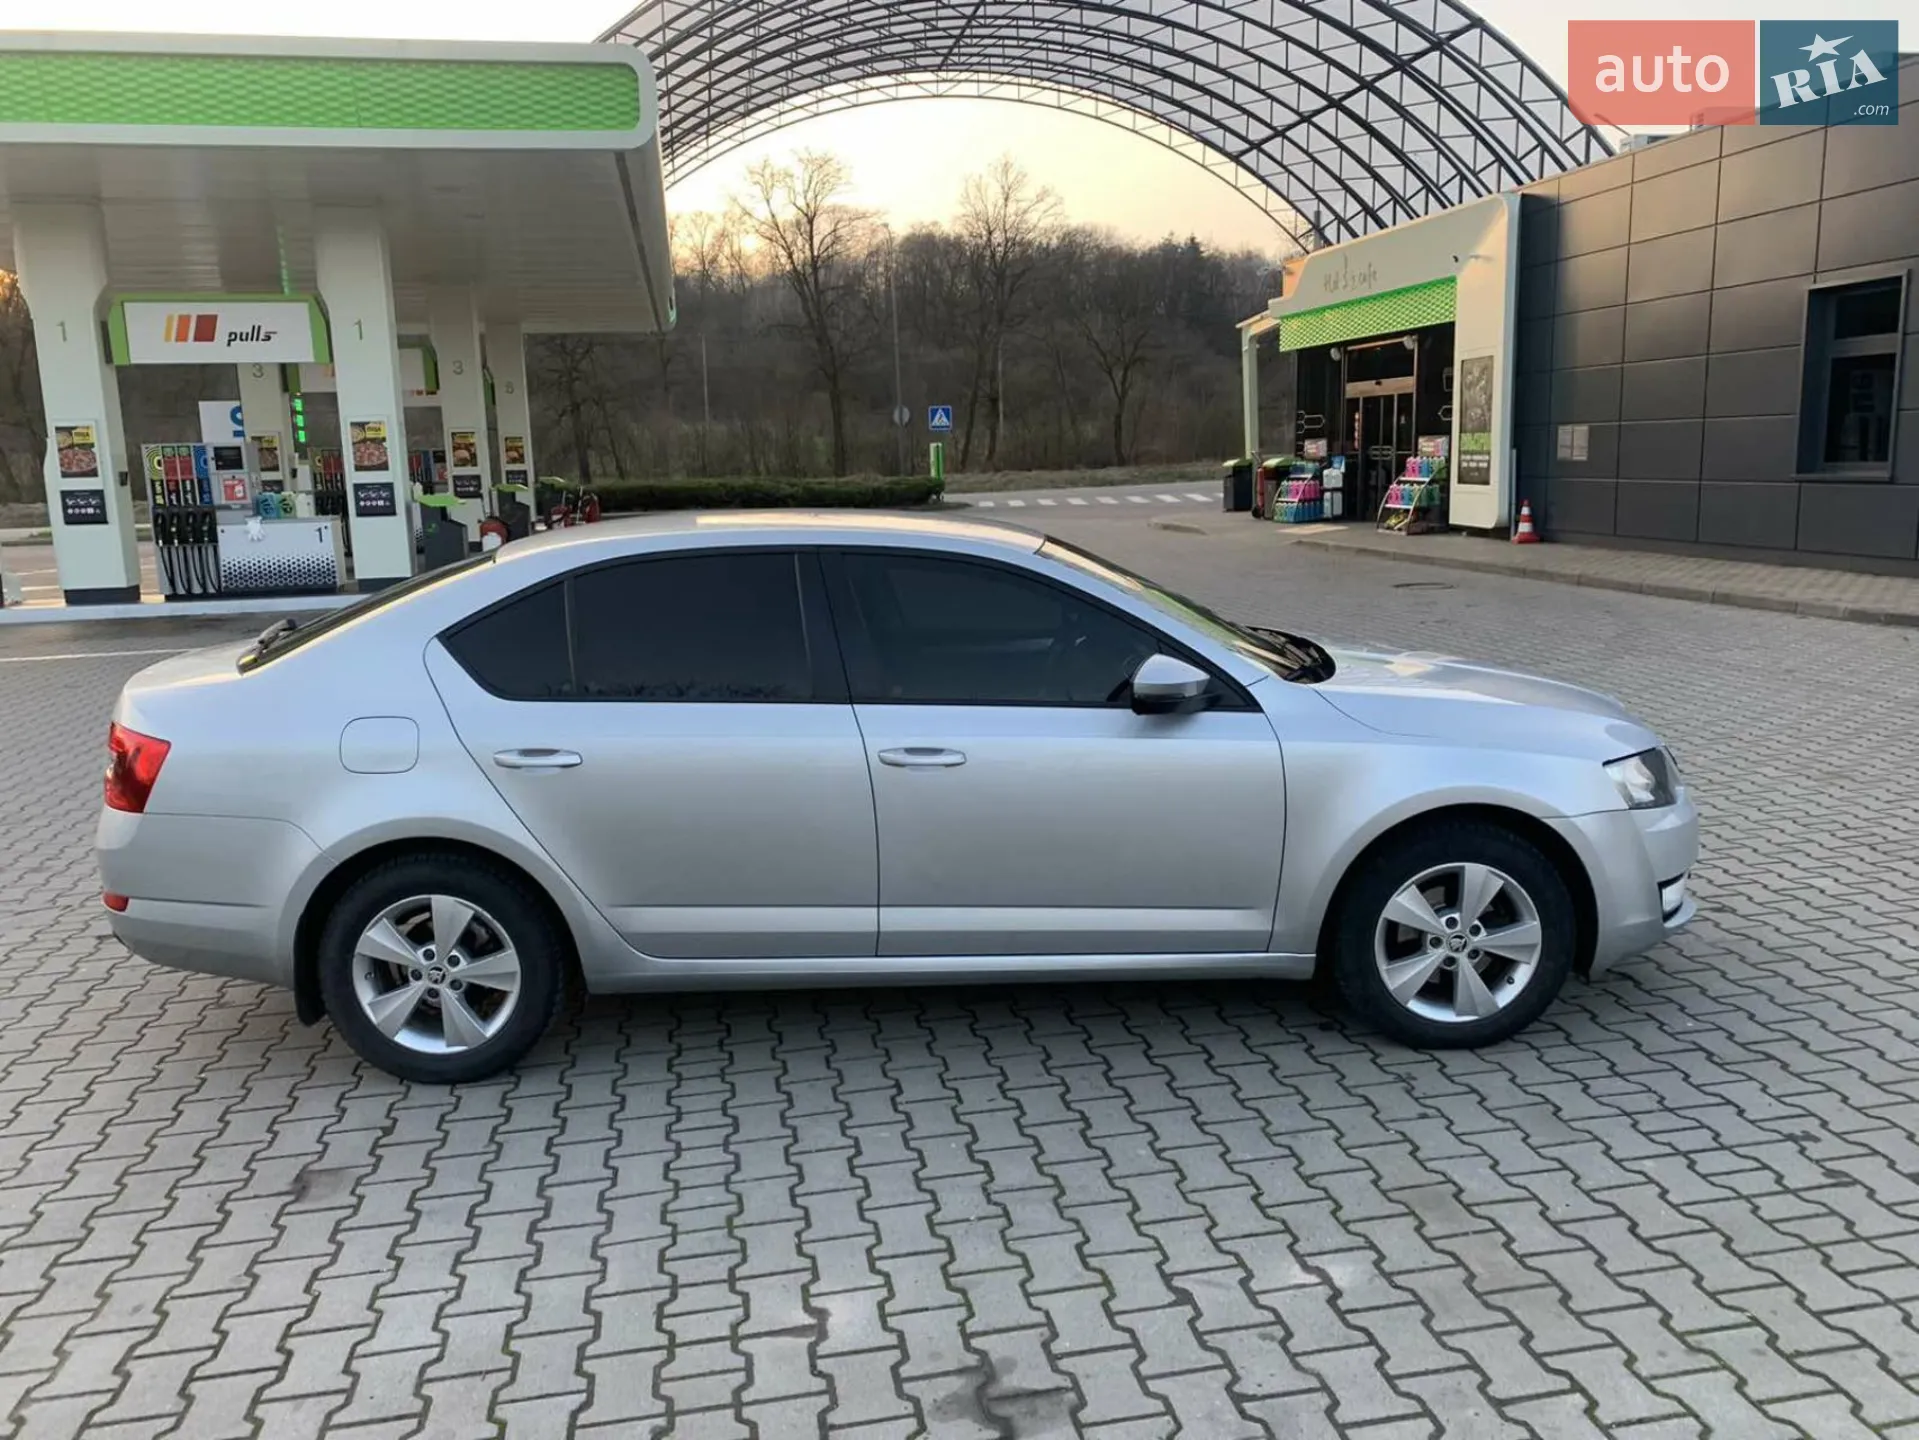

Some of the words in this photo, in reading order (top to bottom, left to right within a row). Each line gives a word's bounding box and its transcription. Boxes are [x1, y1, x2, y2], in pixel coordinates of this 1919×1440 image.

[56, 321, 67, 342] 1
[226, 325, 277, 347] pulls
[354, 319, 363, 341] 1
[252, 362, 264, 378] 3
[453, 361, 464, 375] 3
[315, 527, 323, 543] 1
